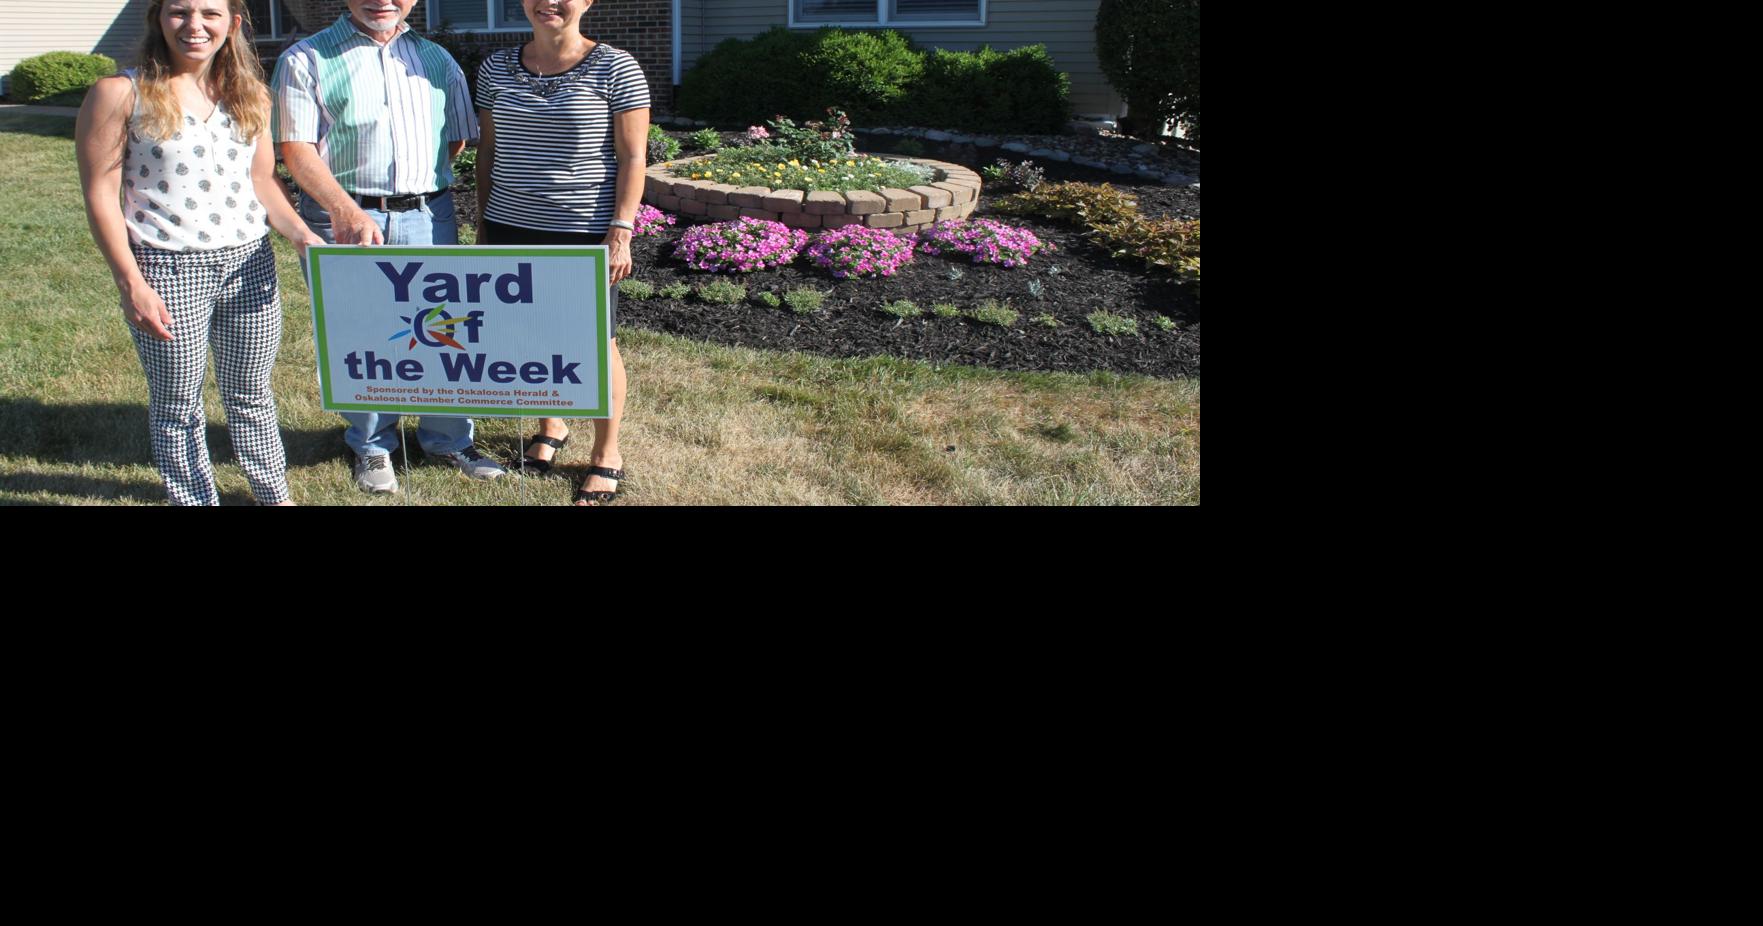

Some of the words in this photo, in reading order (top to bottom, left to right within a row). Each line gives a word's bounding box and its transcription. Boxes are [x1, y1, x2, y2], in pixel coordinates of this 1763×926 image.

[374, 261, 534, 304] Yard
[413, 308, 485, 348] Of
[344, 351, 424, 382] the
[439, 352, 582, 385] Week
[354, 394, 406, 403] Oskaloosa
[409, 395, 455, 404] Chamber
[458, 397, 513, 405] Commerce
[516, 398, 573, 406] Committee
[366, 386, 420, 395] Sponsored
[422, 387, 434, 396] by
[437, 387, 454, 395] the
[457, 388, 511, 396] Oskaloosa
[513, 389, 549, 397] Herald
